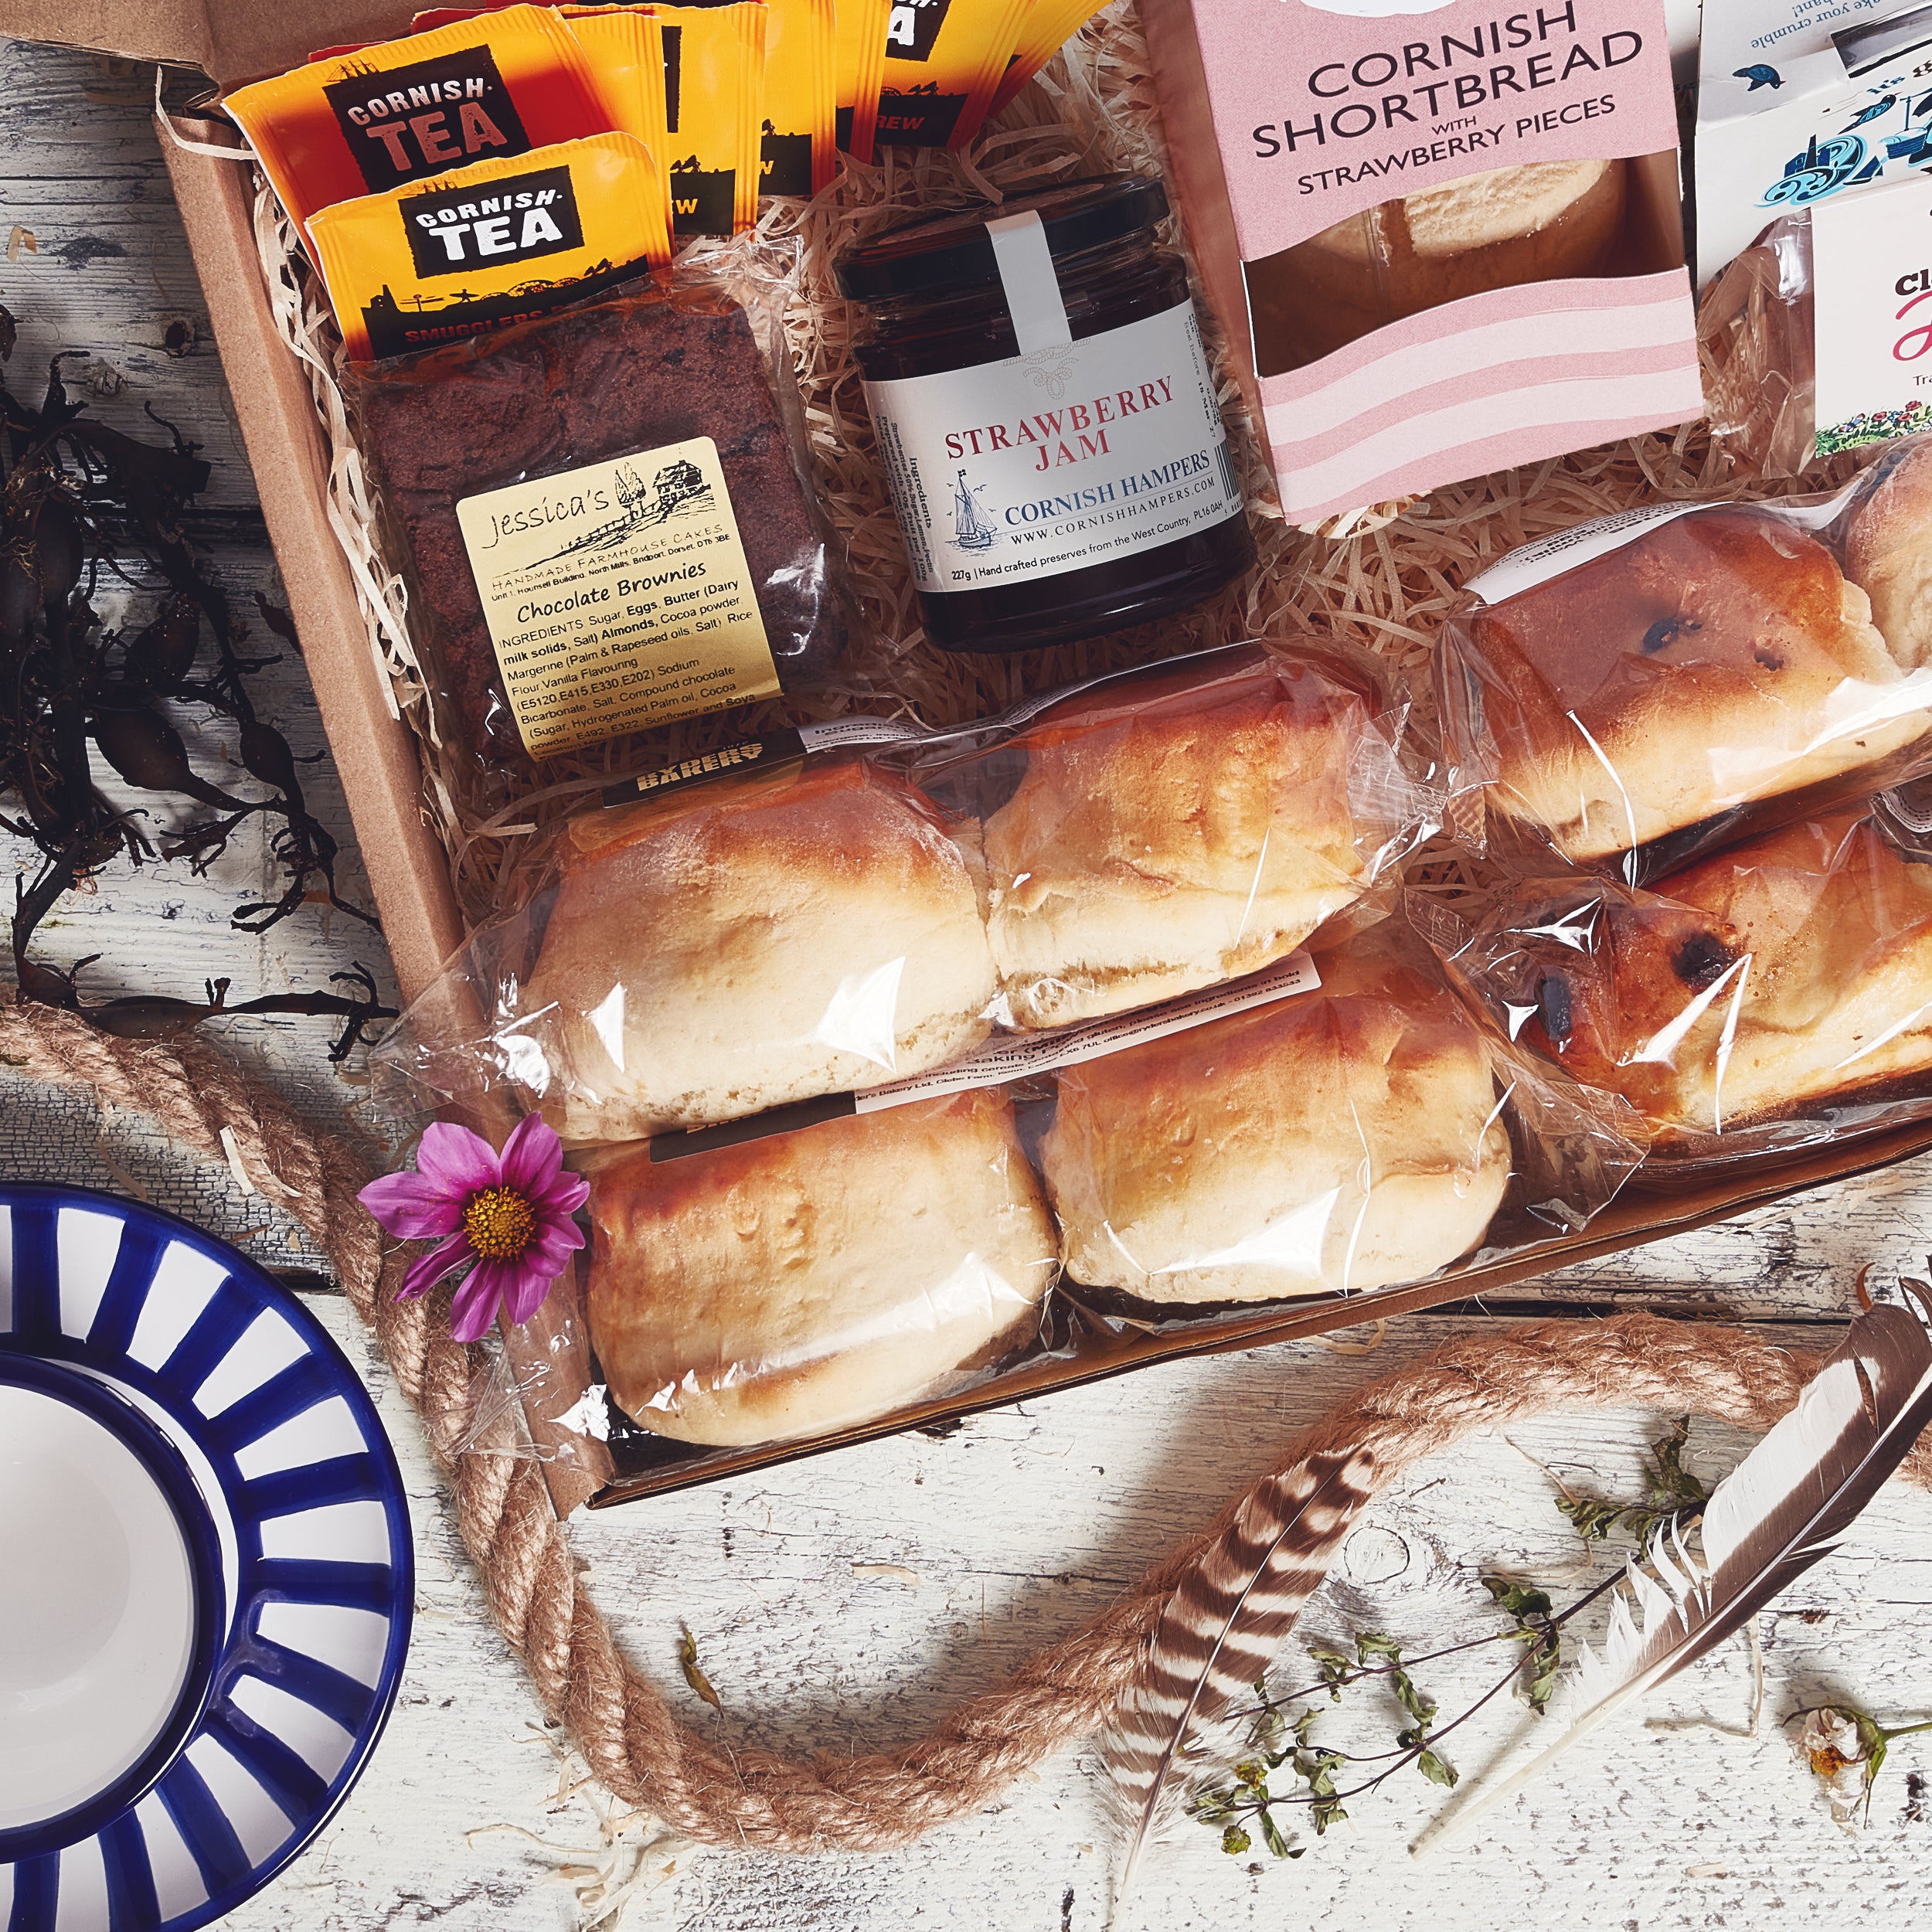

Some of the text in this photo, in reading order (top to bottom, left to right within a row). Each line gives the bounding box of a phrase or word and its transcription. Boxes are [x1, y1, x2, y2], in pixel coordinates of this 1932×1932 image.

[1750, 18, 1812, 49] crumble
[1815, 2, 1851, 22] your
[1308, 0, 1577, 97] CORNISH
[347, 77, 490, 126] CORNISH
[1252, 29, 1643, 158] SHORTBREAD
[365, 101, 509, 172] TEA
[1297, 94, 1616, 195] STRAWBERRY PIECES
[1431, 115, 1478, 135] WITH
[415, 189, 556, 228] CORNISH
[428, 207, 563, 260] TEA
[1183, 321, 1200, 376] Best Before
[945, 375, 1175, 460] STRAWBERRY
[890, 422, 908, 472] Strawberries
[903, 472, 914, 492] 50%
[1035, 428, 1112, 471] JAM
[881, 416, 899, 461] Prepared
[895, 464, 904, 487] with
[900, 490, 910, 509] 50g
[906, 512, 915, 533] fruit
[912, 537, 921, 555] per
[909, 457, 932, 529] Ingredients
[1005, 449, 1213, 526] CORNISH HAMPERS
[1010, 476, 1215, 545] WWW.CORNISHHAMPERS.COM
[481, 489, 610, 549] Jessica's
[951, 570, 971, 581] 227g
[978, 563, 1002, 577] Hand
[1004, 557, 1038, 573] crafted
[1039, 548, 1087, 568] preserves
[1088, 542, 1113, 553] from
[1114, 536, 1131, 546] the
[1131, 527, 1156, 541] West
[1156, 516, 1191, 533] Country,
[1193, 505, 1211, 520] PL16
[491, 592, 509, 601] Unit
[517, 580, 552, 595] Hounsell
[588, 566, 610, 576] North
[492, 523, 723, 591] HANDMADE FARMHOUSE CAKES
[498, 619, 584, 649] INGREDIENTS
[663, 590, 700, 607] Butter
[703, 580, 738, 598] (Dairy
[517, 562, 706, 624] Chocolate Brownies
[503, 651, 529, 666] milk
[530, 642, 571, 658] solids,
[573, 632, 599, 648] Salt)
[601, 618, 658, 641] Almonds,
[660, 608, 697, 624] Cocoa
[507, 661, 564, 682] Margerine
[566, 651, 599, 668] (Palm
[600, 647, 610, 658] &
[611, 631, 668, 655] Rapeseed
[726, 611, 753, 624] Rice
[580, 658, 638, 680] Flavouring
[618, 678, 680, 702] Compound
[682, 666, 738, 687] chocolate
[656, 659, 700, 676] Sodium
[570, 702, 651, 729] Hydrogenated
[648, 698, 679, 711] Palm
[699, 683, 736, 699] Cocoa
[645, 708, 699, 725] Sunflower
[703, 702, 723, 713] and
[726, 694, 756, 706] Soya
[1194, 982, 1258, 1006] ingredients
[1274, 970, 1301, 981] bold
[1082, 1040, 1102, 1050] 7UL
